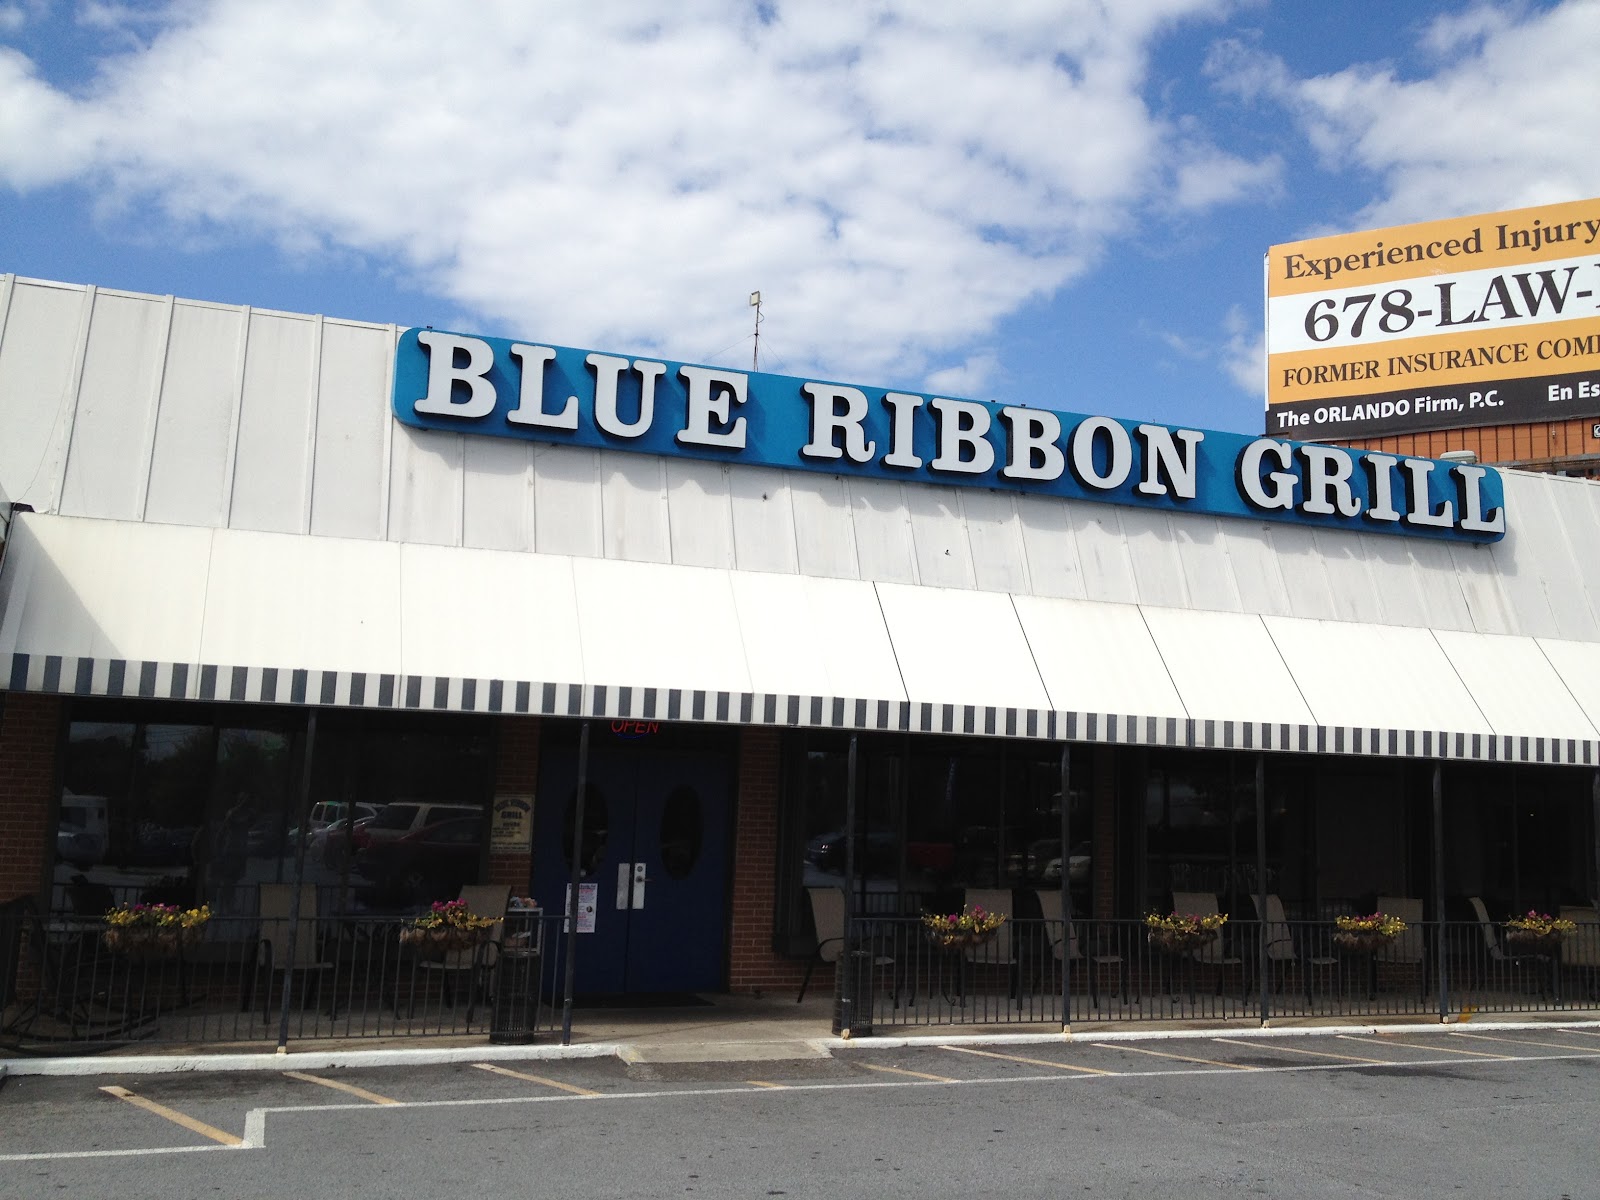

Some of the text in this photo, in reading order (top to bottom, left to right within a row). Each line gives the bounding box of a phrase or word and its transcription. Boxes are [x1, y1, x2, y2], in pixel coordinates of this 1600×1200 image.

[1283, 218, 1600, 280] Experienced Injury
[1304, 262, 1600, 342] 678-LAW-
[1283, 360, 1380, 387] FORMER
[1387, 343, 1529, 376] INSURANCE
[414, 331, 1504, 533] BLUE RIBBON GRILL
[1277, 411, 1310, 428] The
[1313, 399, 1410, 424] ORLANDO
[1414, 395, 1464, 414] Firm,
[1469, 390, 1505, 409] P.C.
[1548, 384, 1573, 402] En
[611, 719, 659, 734] OPEN
